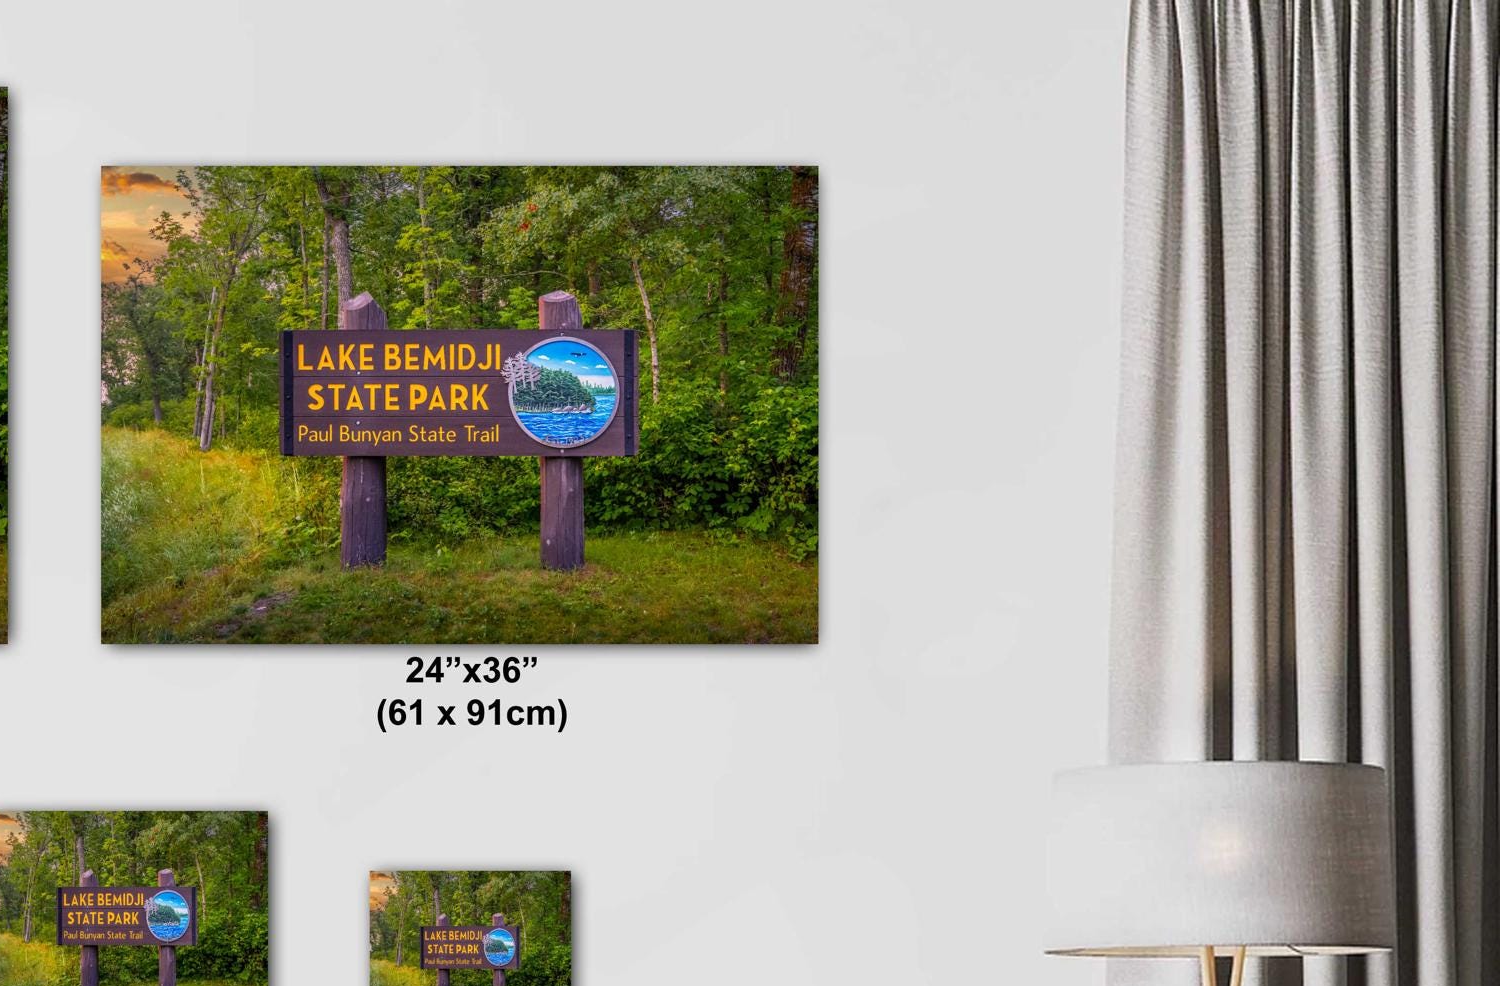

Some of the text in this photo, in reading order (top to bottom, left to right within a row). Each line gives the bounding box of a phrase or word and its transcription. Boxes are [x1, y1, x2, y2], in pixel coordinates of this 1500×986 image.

[297, 343, 501, 371] LAKE BEMIDJI
[307, 383, 490, 411] STATE PARK
[298, 424, 500, 446] Paul Bunyan State Trail
[63, 893, 144, 906] LAKE BEMIDJI
[67, 911, 139, 925] STATE PARK
[63, 930, 78, 939] Paul
[107, 930, 127, 940] State
[129, 930, 144, 940] Trail
[424, 930, 483, 941] LAKE BEMIDJI
[427, 944, 479, 954] STATE PARK
